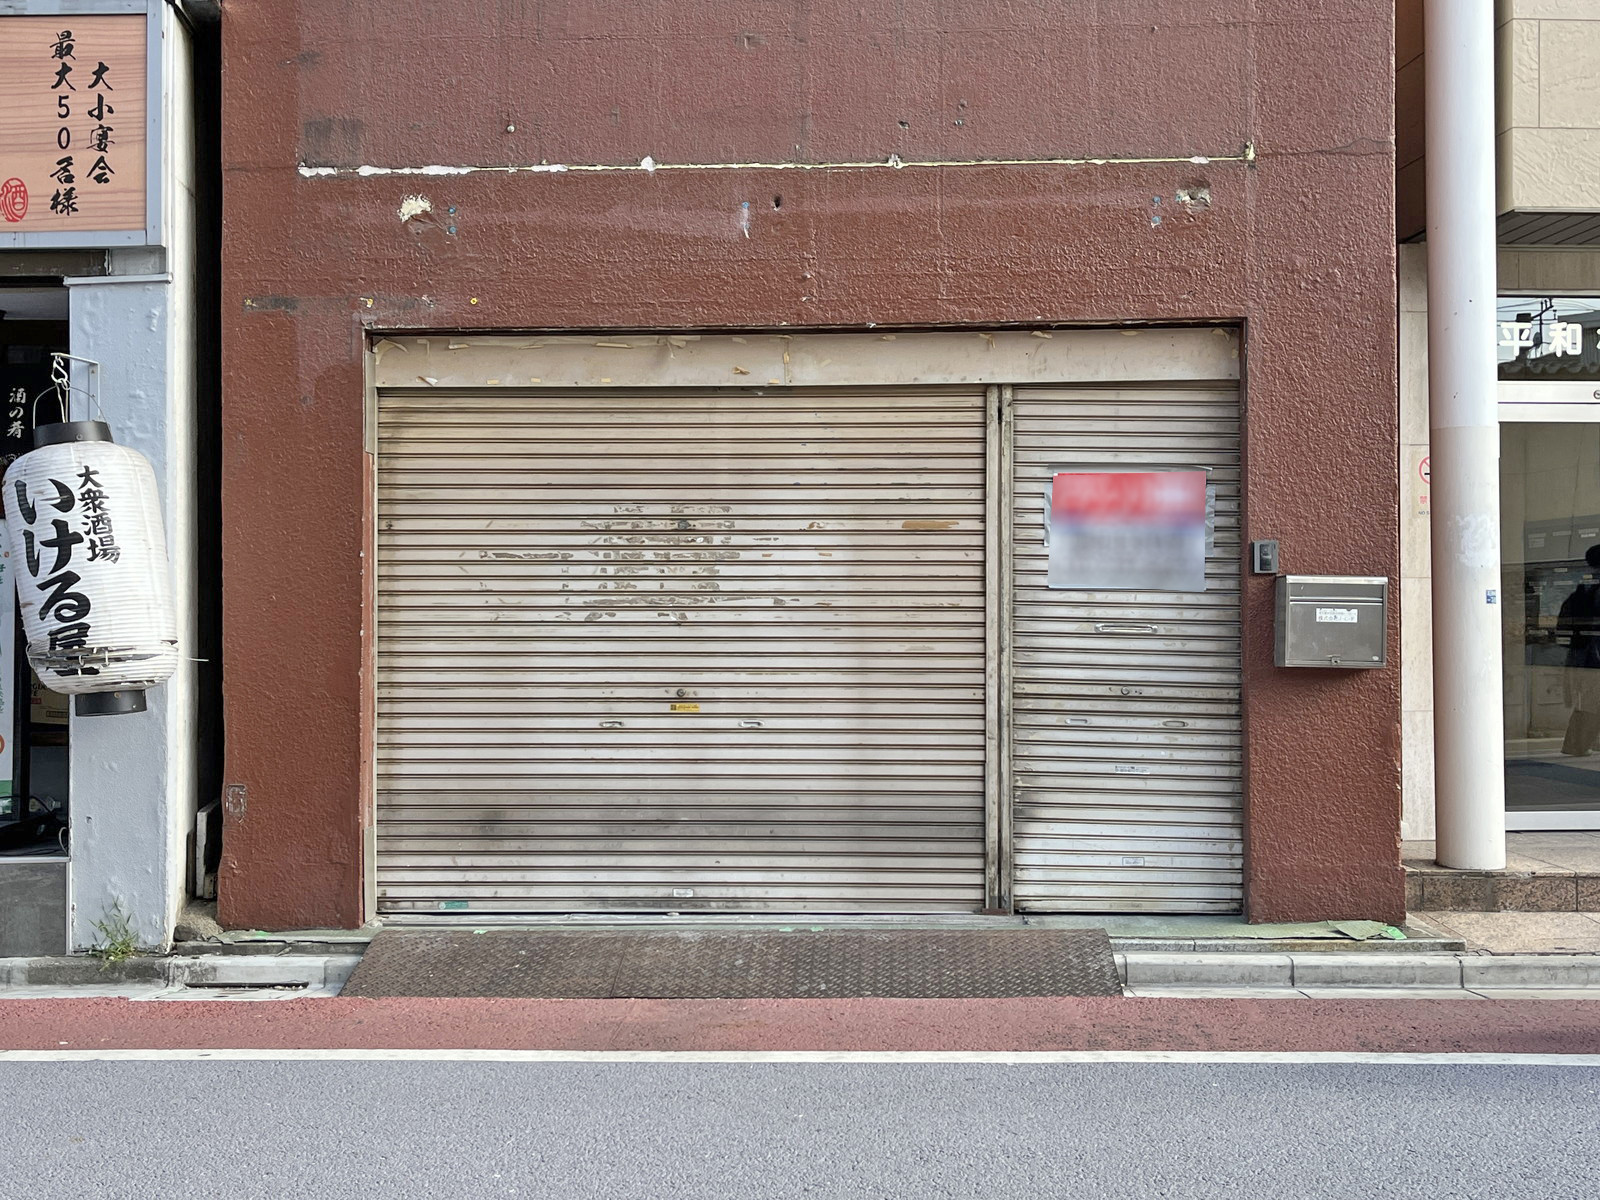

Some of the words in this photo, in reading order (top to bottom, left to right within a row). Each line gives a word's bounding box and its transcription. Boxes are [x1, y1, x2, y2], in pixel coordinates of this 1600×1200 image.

[87, 61, 115, 184] 大小宴会
[1499, 322, 1600, 357] 平和
[77, 465, 121, 565] 大衆酒場
